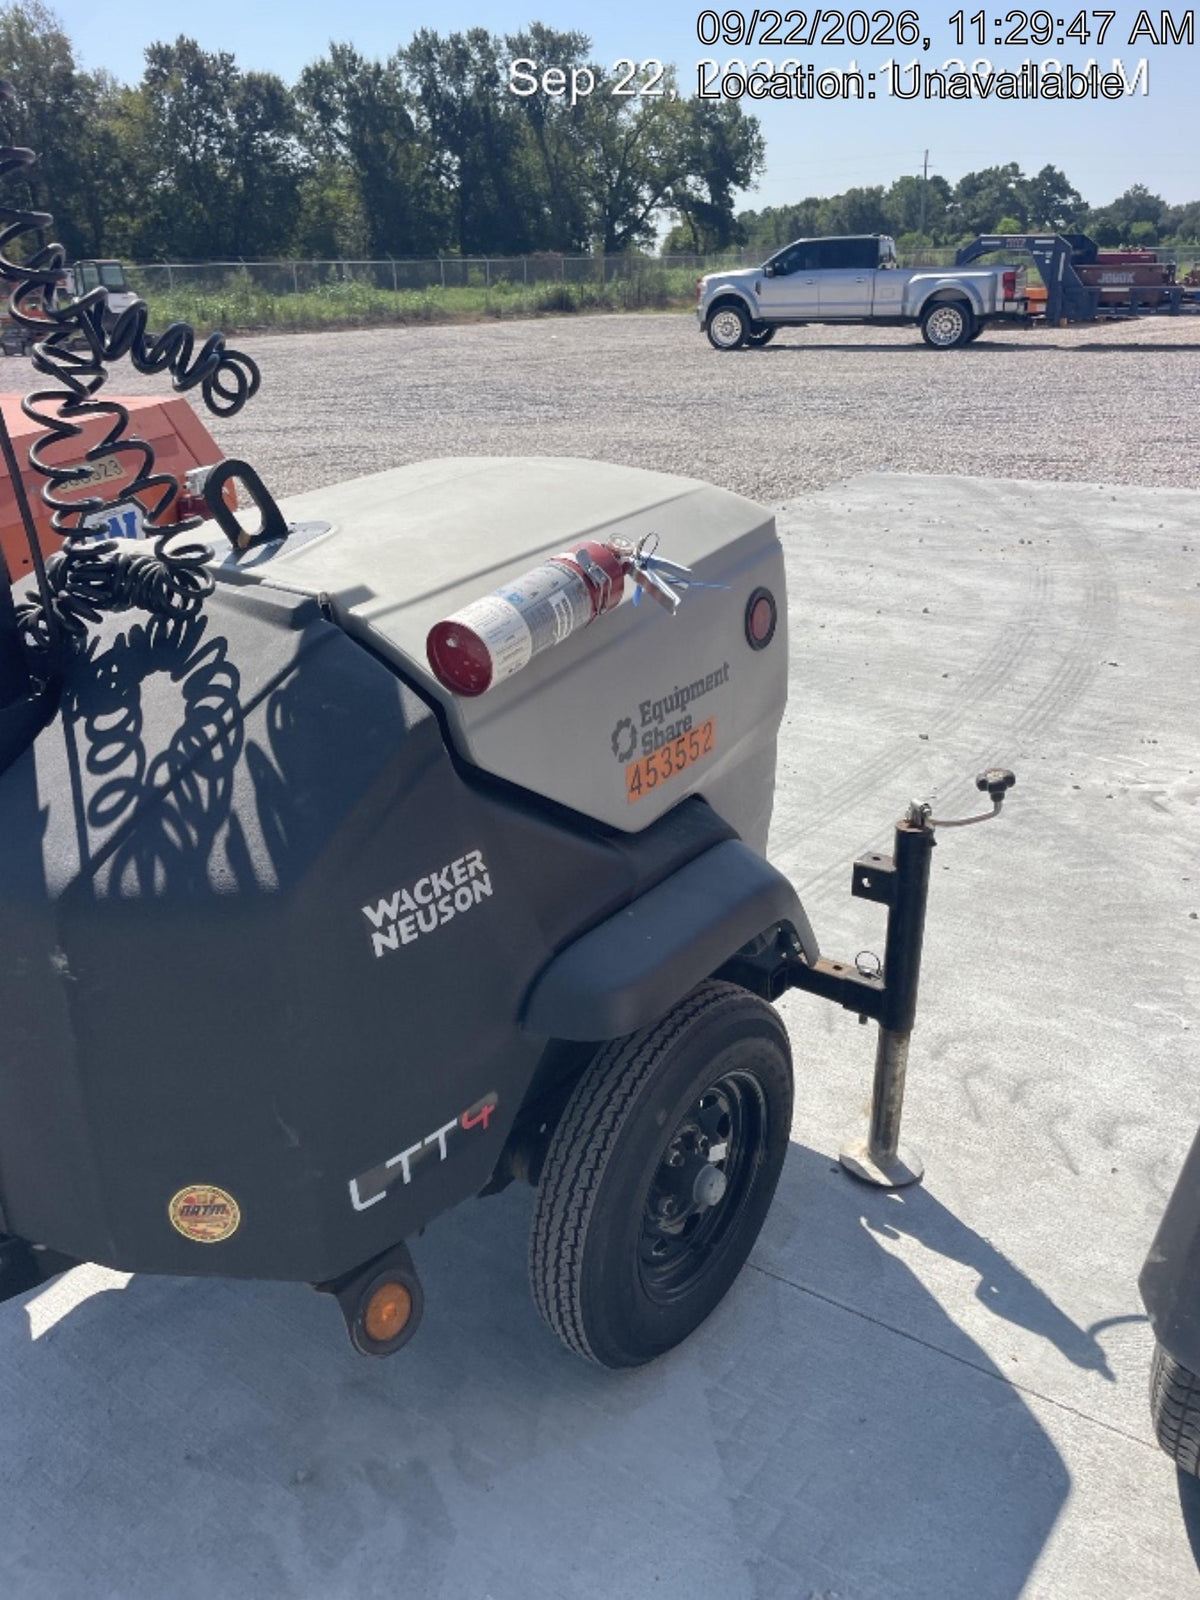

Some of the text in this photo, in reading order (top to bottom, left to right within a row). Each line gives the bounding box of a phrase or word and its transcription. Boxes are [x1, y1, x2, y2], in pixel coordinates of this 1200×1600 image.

[639, 660, 730, 728] Equipment
[629, 720, 714, 796] 453552
[641, 714, 693, 756] Share
[361, 849, 488, 928] WACKER
[371, 872, 494, 958] NEUSON
